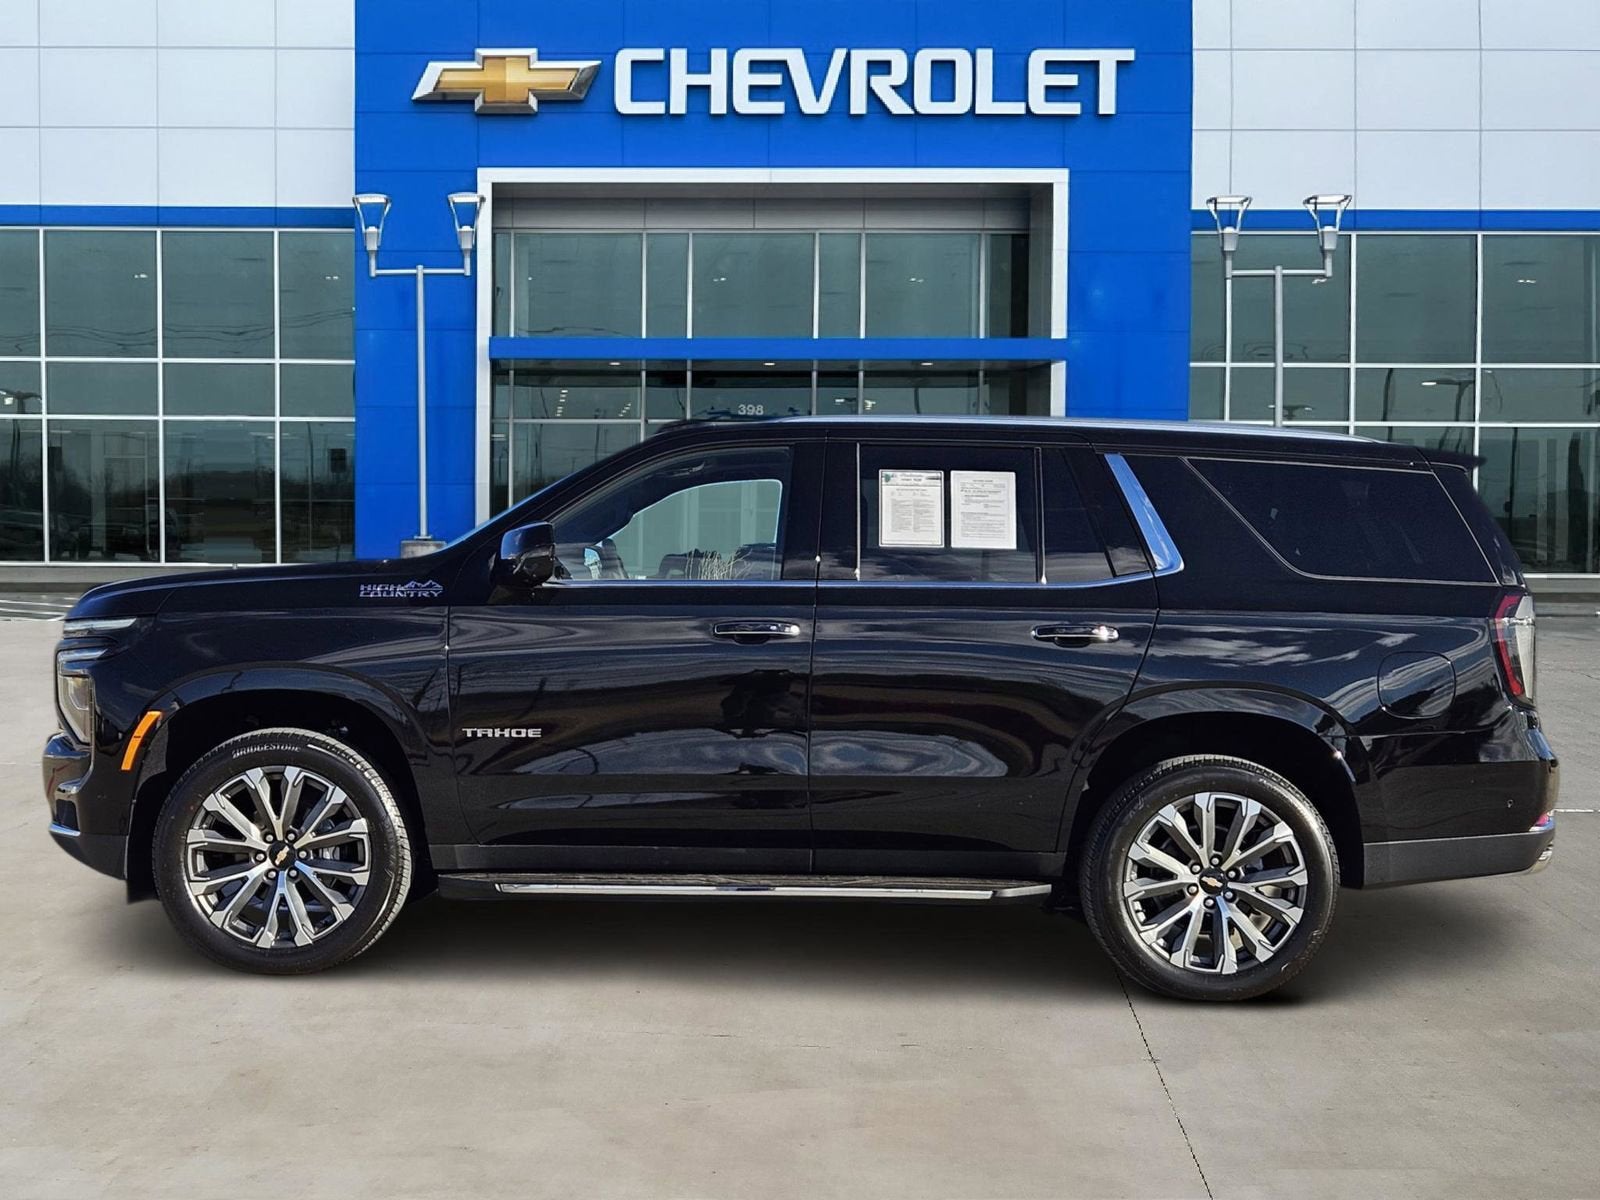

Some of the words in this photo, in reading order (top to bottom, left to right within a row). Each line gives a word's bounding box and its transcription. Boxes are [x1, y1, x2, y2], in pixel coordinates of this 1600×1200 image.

[614, 47, 1135, 115] CHEVROLET
[738, 404, 764, 416] 398
[462, 728, 542, 738] TAHOE
[232, 743, 301, 759] BRIDGESTONE
